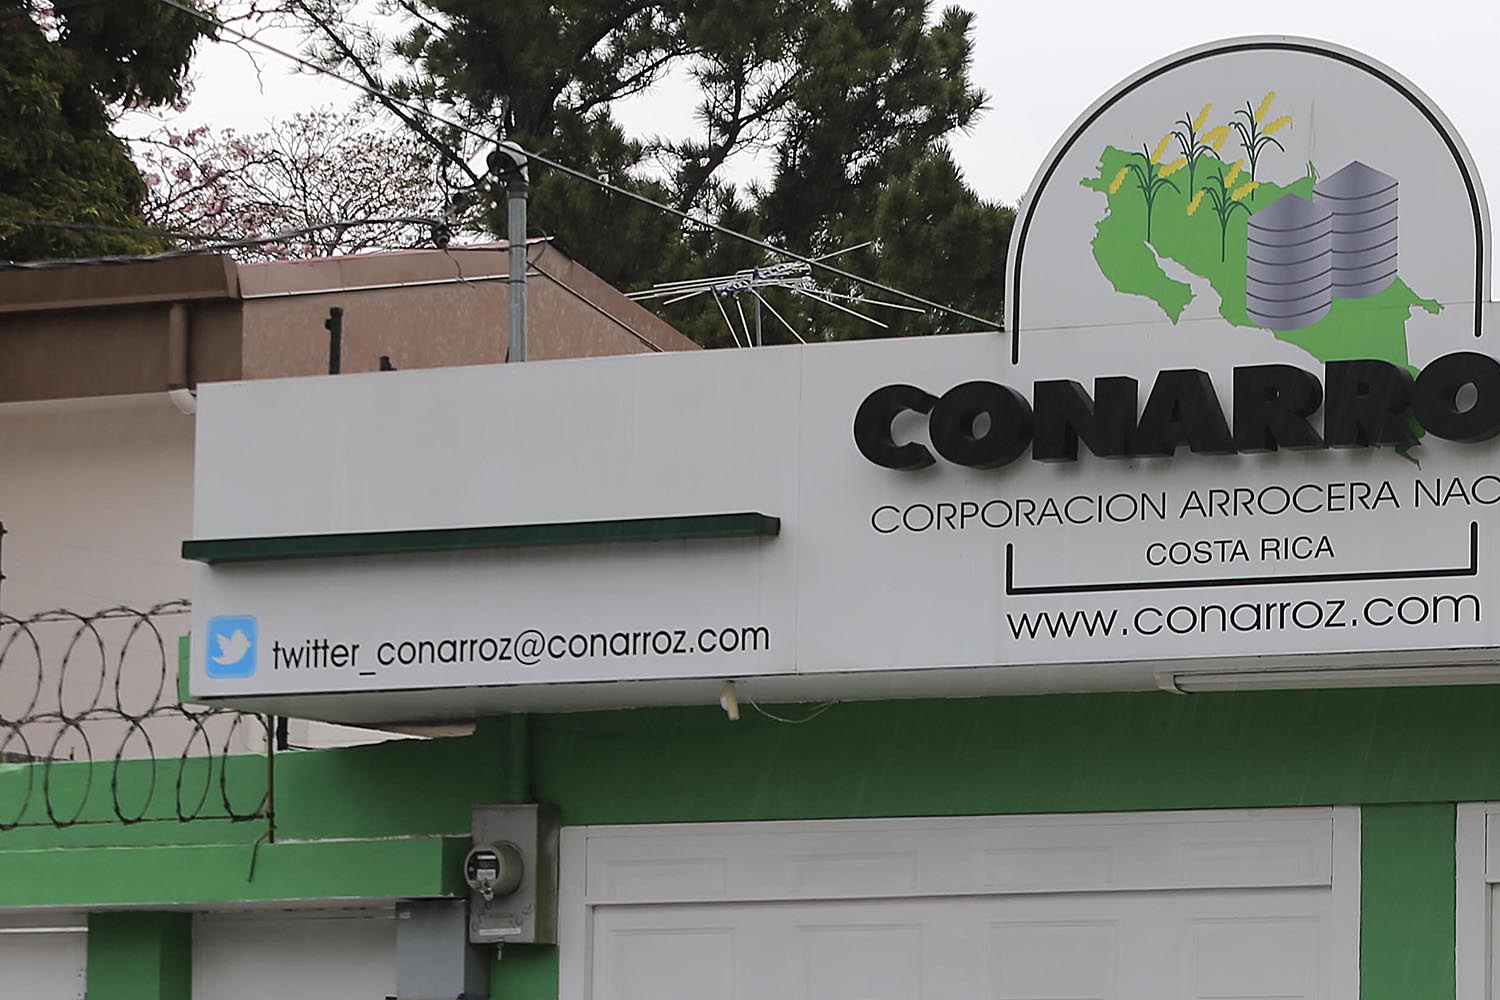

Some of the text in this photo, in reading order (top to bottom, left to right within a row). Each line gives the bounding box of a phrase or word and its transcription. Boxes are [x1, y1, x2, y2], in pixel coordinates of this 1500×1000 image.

[871, 492, 1167, 534] CORPORACION
[1179, 480, 1400, 521] ARROCERA
[1145, 534, 1336, 566] COSTA RICA
[1006, 590, 1482, 641] www.conarroz.com
[272, 624, 771, 677] twitter_conarroz@conarroz.com
